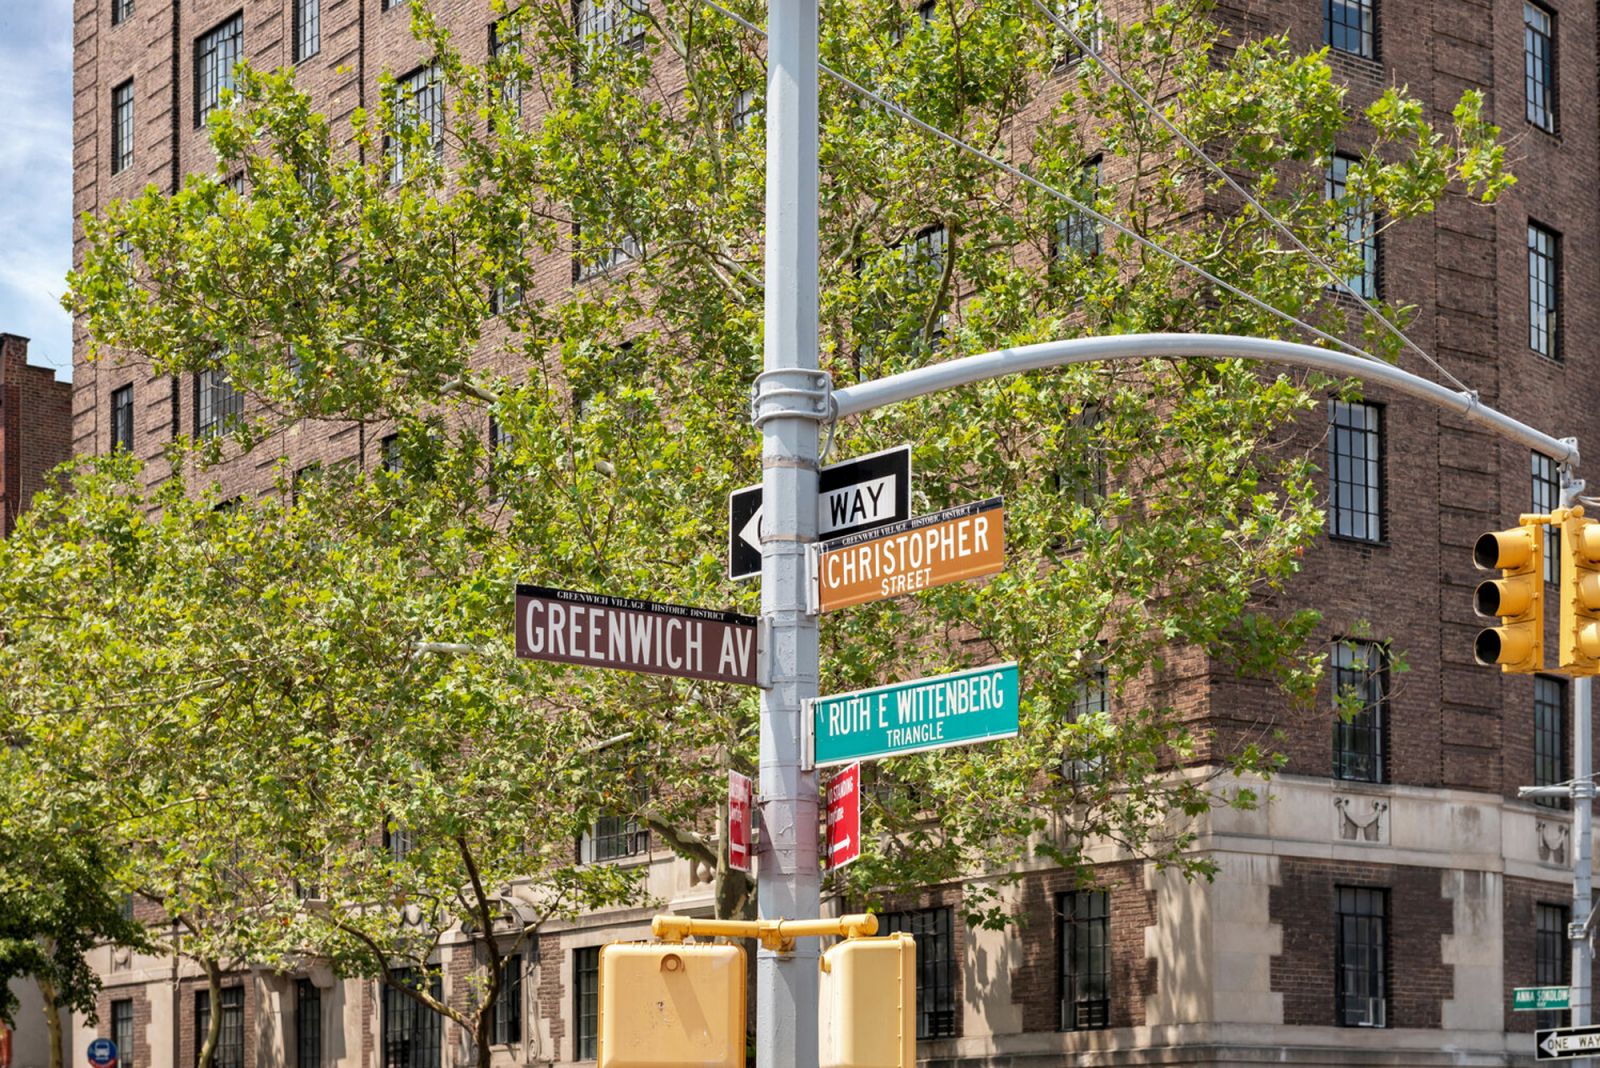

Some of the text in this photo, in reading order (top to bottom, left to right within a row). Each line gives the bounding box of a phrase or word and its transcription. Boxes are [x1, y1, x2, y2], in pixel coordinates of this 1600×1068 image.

[830, 482, 884, 527] WAY
[842, 506, 971, 546] GREENWICH VILLAGE HISTORIC DISTRICT
[828, 516, 989, 589] CHRISTOPHER
[881, 567, 932, 596] STREET
[557, 591, 726, 621] GREENWICH VILLAGE HISTORIC DISTRICT
[526, 599, 752, 677] GREENWICH AV
[829, 672, 1004, 737] RUTH E WITTENBERG
[886, 721, 944, 747] TRIANGLE
[1547, 1037, 1600, 1050] ONE WAY
